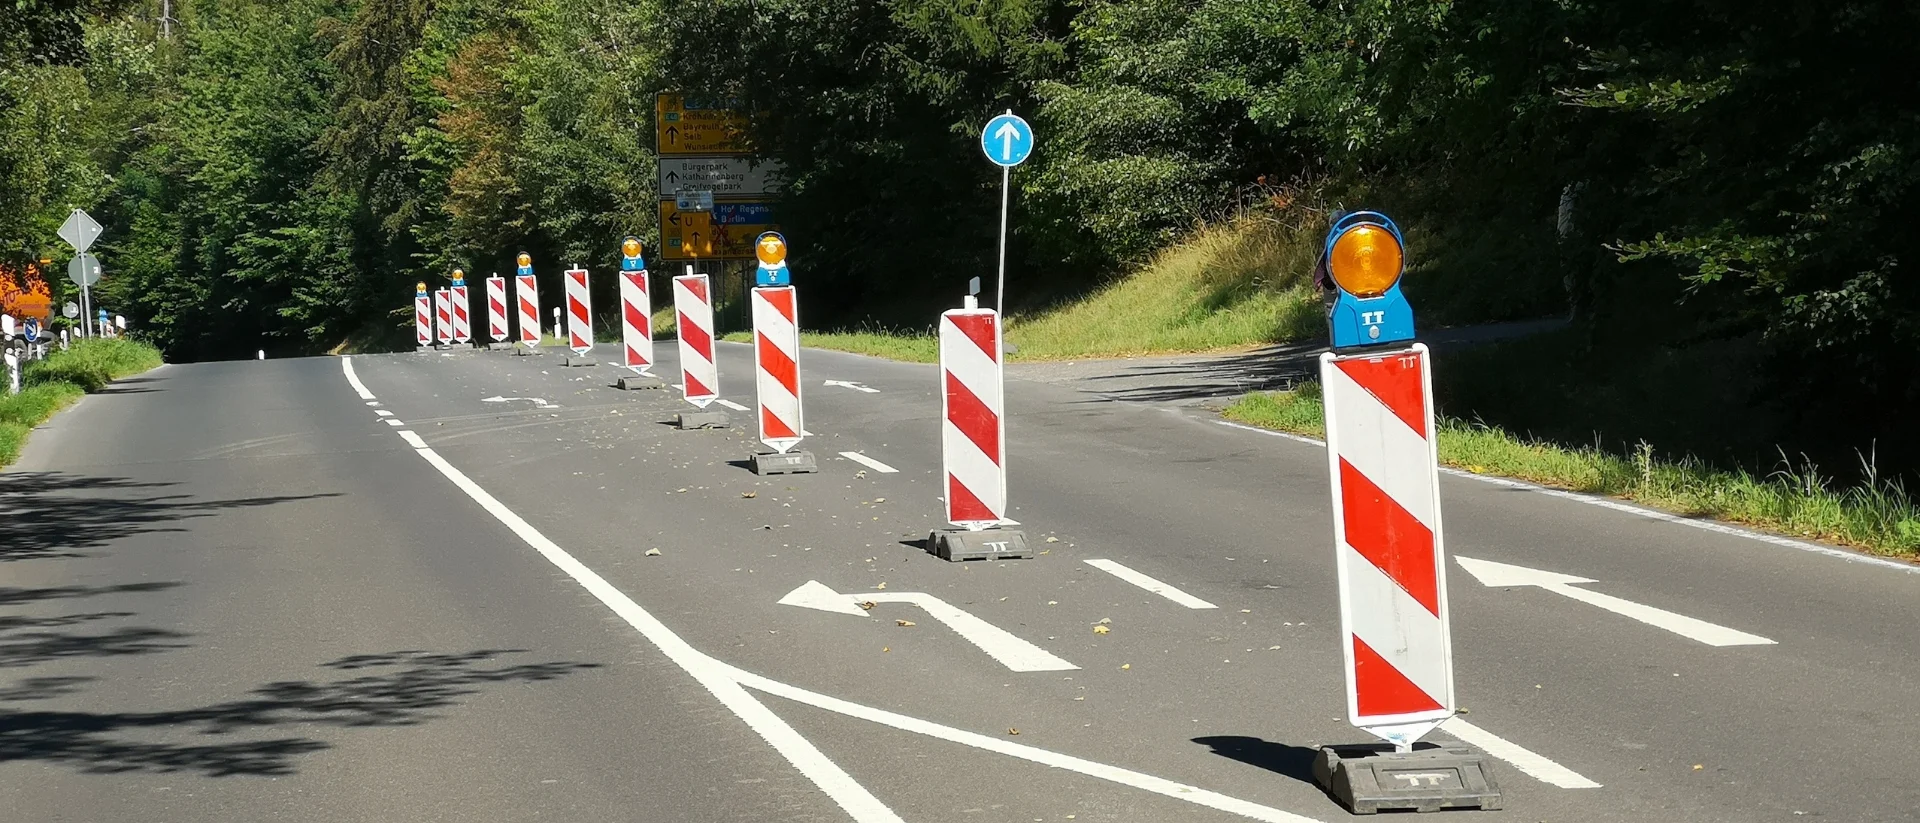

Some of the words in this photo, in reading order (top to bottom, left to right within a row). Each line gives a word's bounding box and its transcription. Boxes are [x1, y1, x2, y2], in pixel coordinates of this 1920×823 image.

[683, 123, 720, 131] Bayreuth
[683, 132, 702, 140] Selb
[683, 163, 728, 172] Bürgerpark
[682, 173, 744, 181] Katharinenberg
[682, 183, 742, 191] Greifvogelpark
